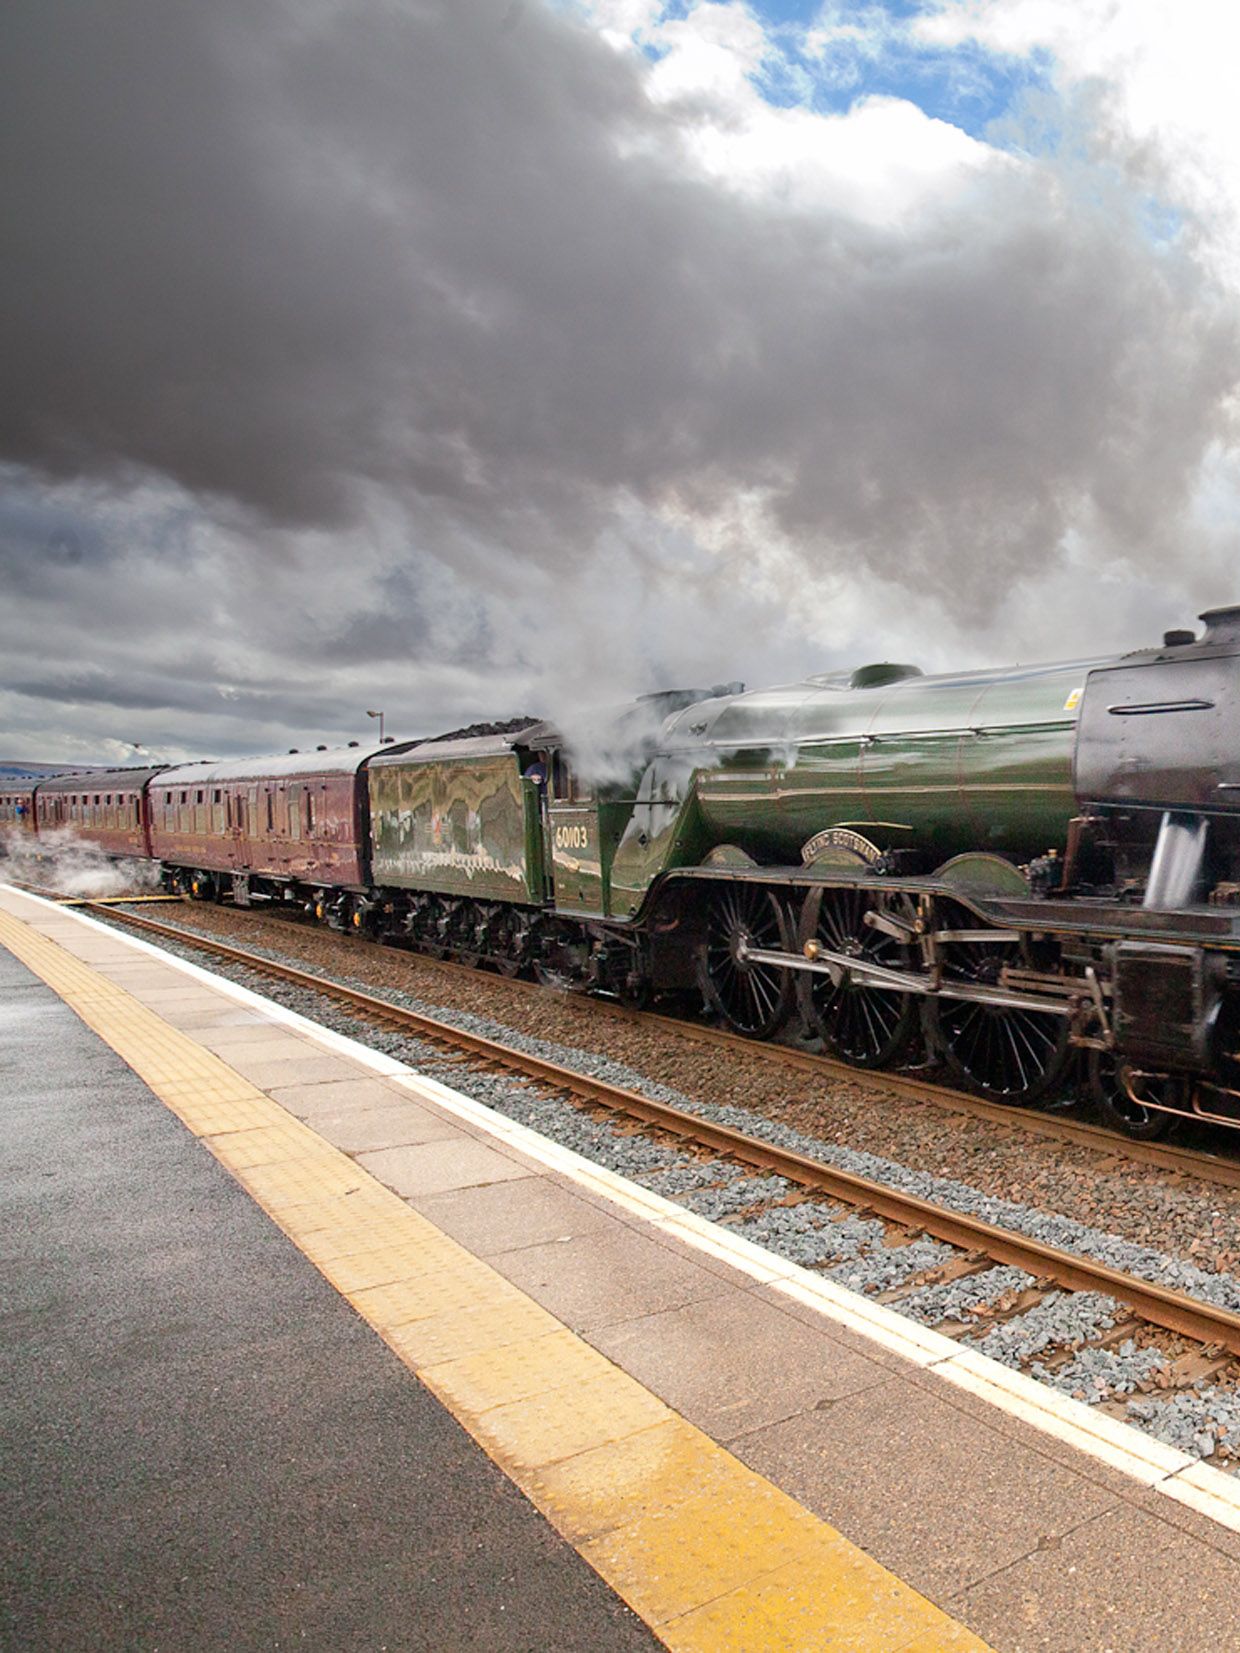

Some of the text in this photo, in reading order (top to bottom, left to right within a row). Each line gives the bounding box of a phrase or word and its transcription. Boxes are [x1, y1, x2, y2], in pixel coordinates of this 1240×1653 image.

[555, 826, 588, 849] 60103
[804, 831, 878, 864] FLYING SCOTSMAN
